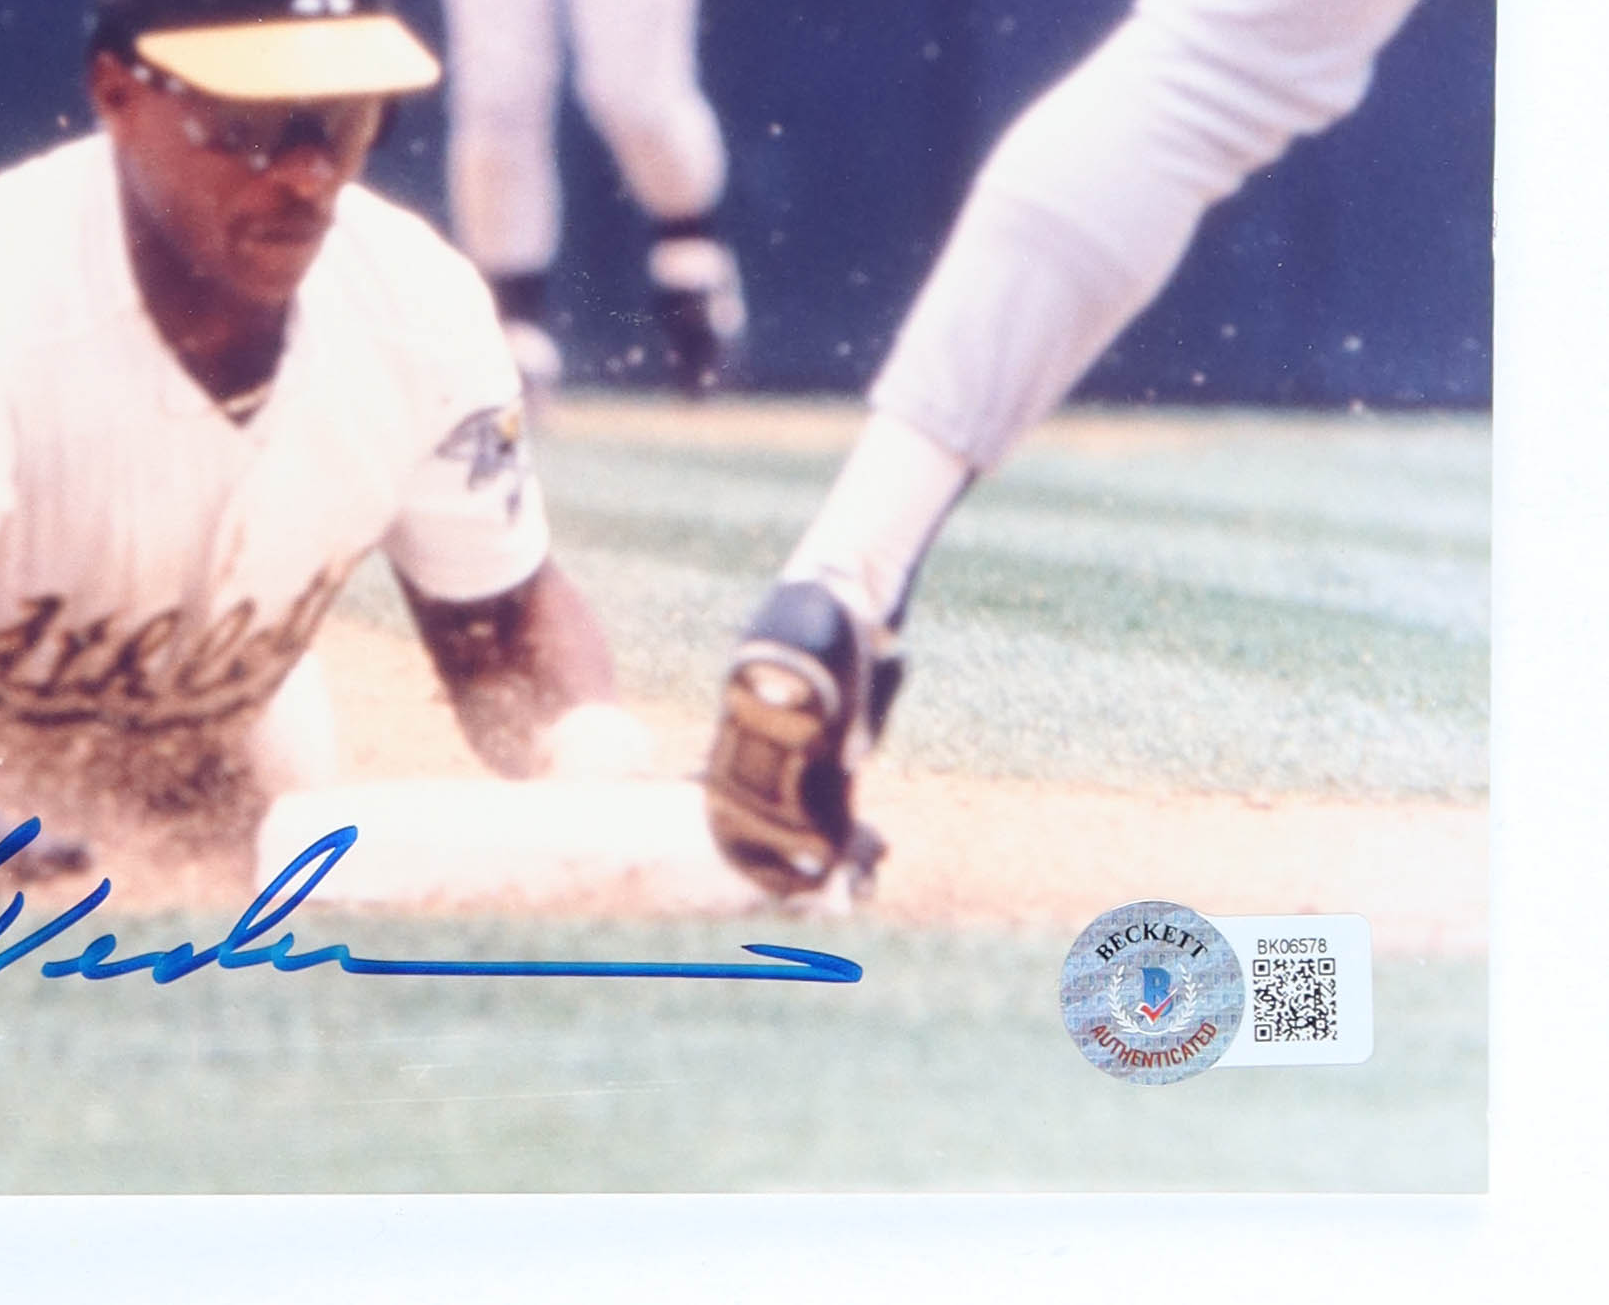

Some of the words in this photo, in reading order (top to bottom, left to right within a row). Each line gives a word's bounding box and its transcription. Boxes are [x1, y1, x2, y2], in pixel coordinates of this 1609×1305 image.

[1094, 922, 1209, 963] BECKETT
[1257, 938, 1328, 956] BK06578
[1090, 1021, 1219, 1069] AUTHENTICATED
